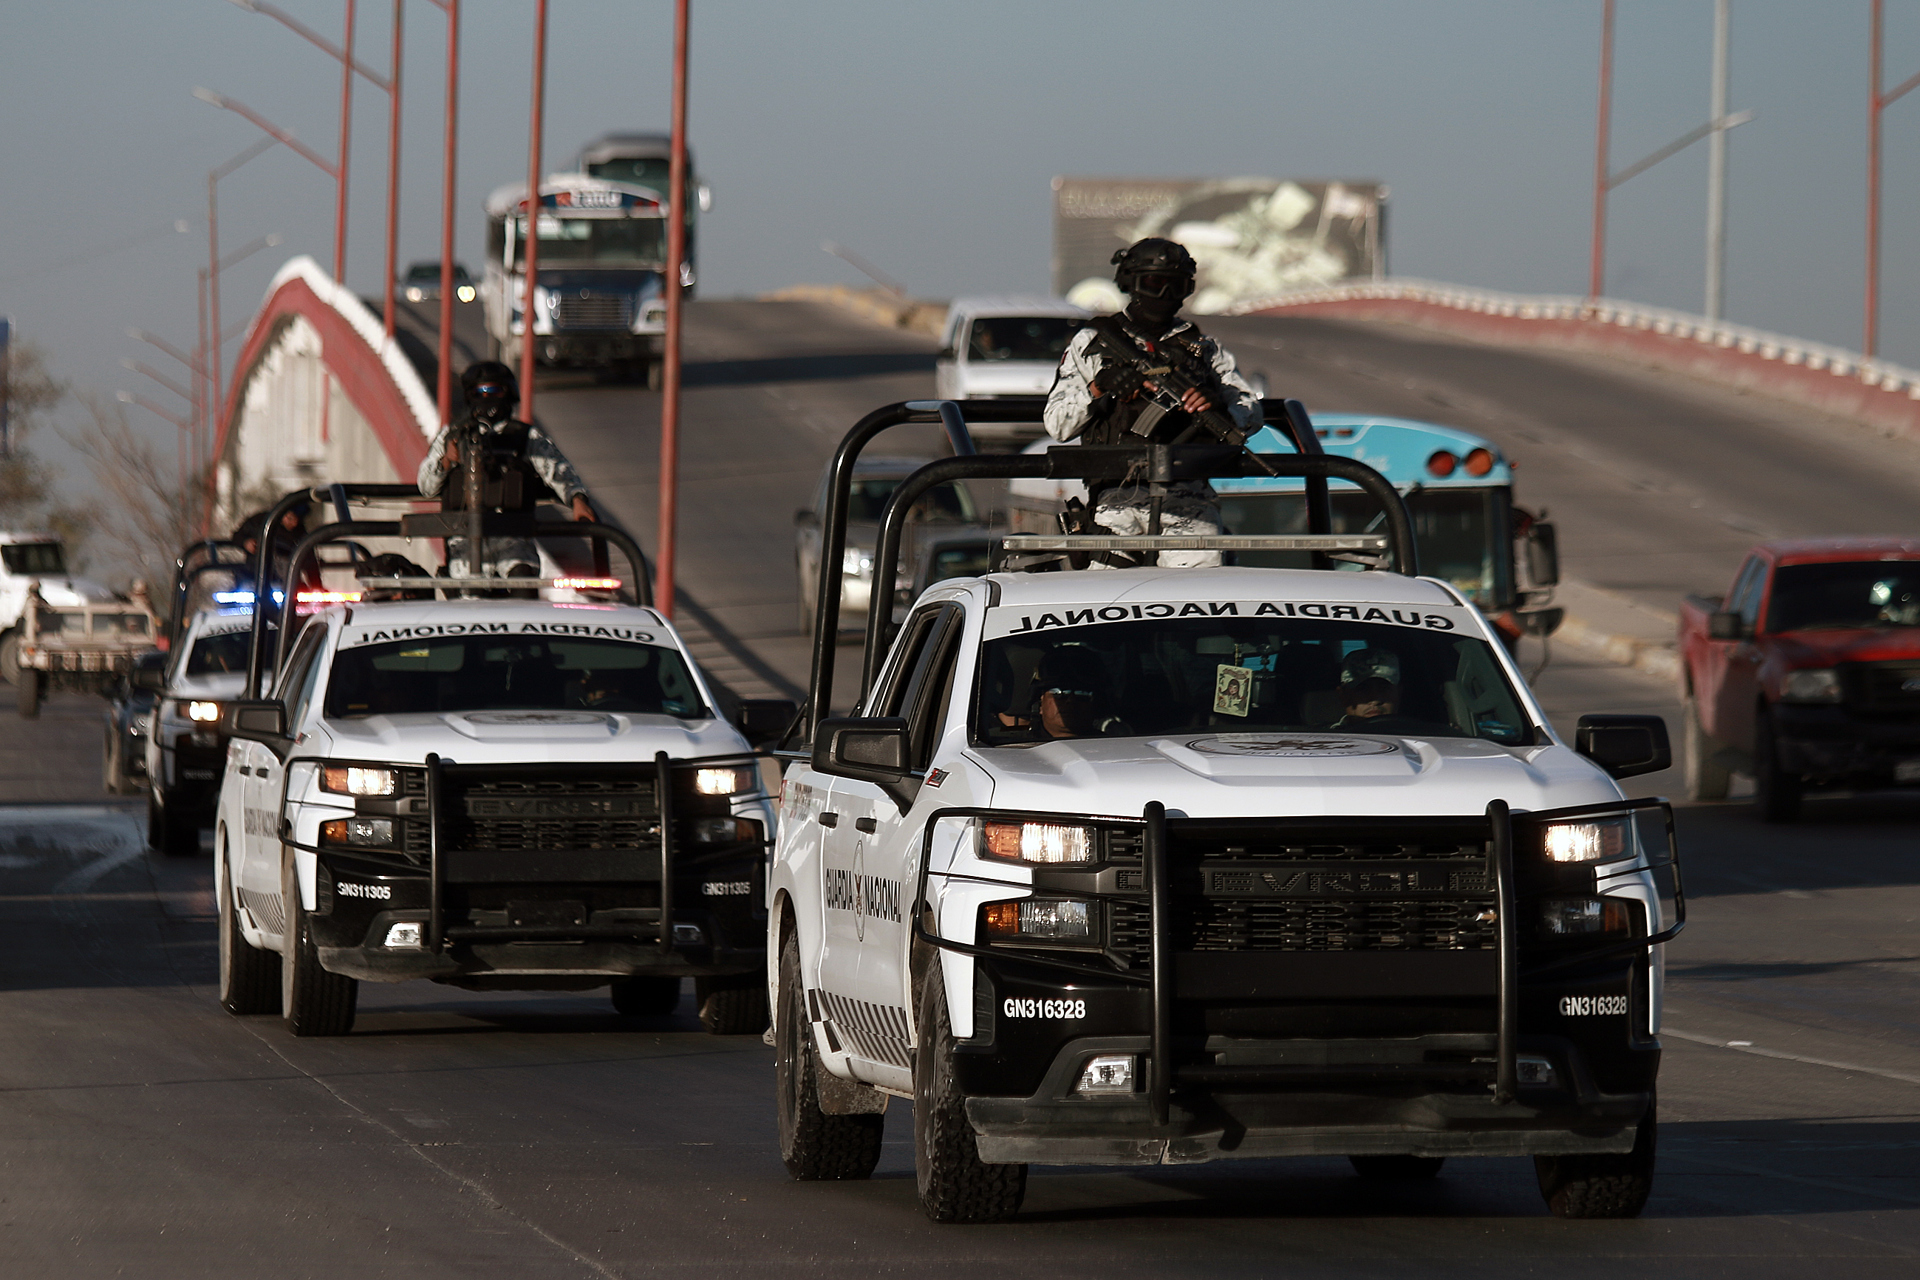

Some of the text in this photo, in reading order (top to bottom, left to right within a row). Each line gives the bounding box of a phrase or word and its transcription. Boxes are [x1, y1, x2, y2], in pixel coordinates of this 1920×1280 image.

[826, 868, 901, 923] GUARDIA NACIONAL
[1003, 998, 1086, 1019] GN316328
[1559, 996, 1627, 1016] GN316328
